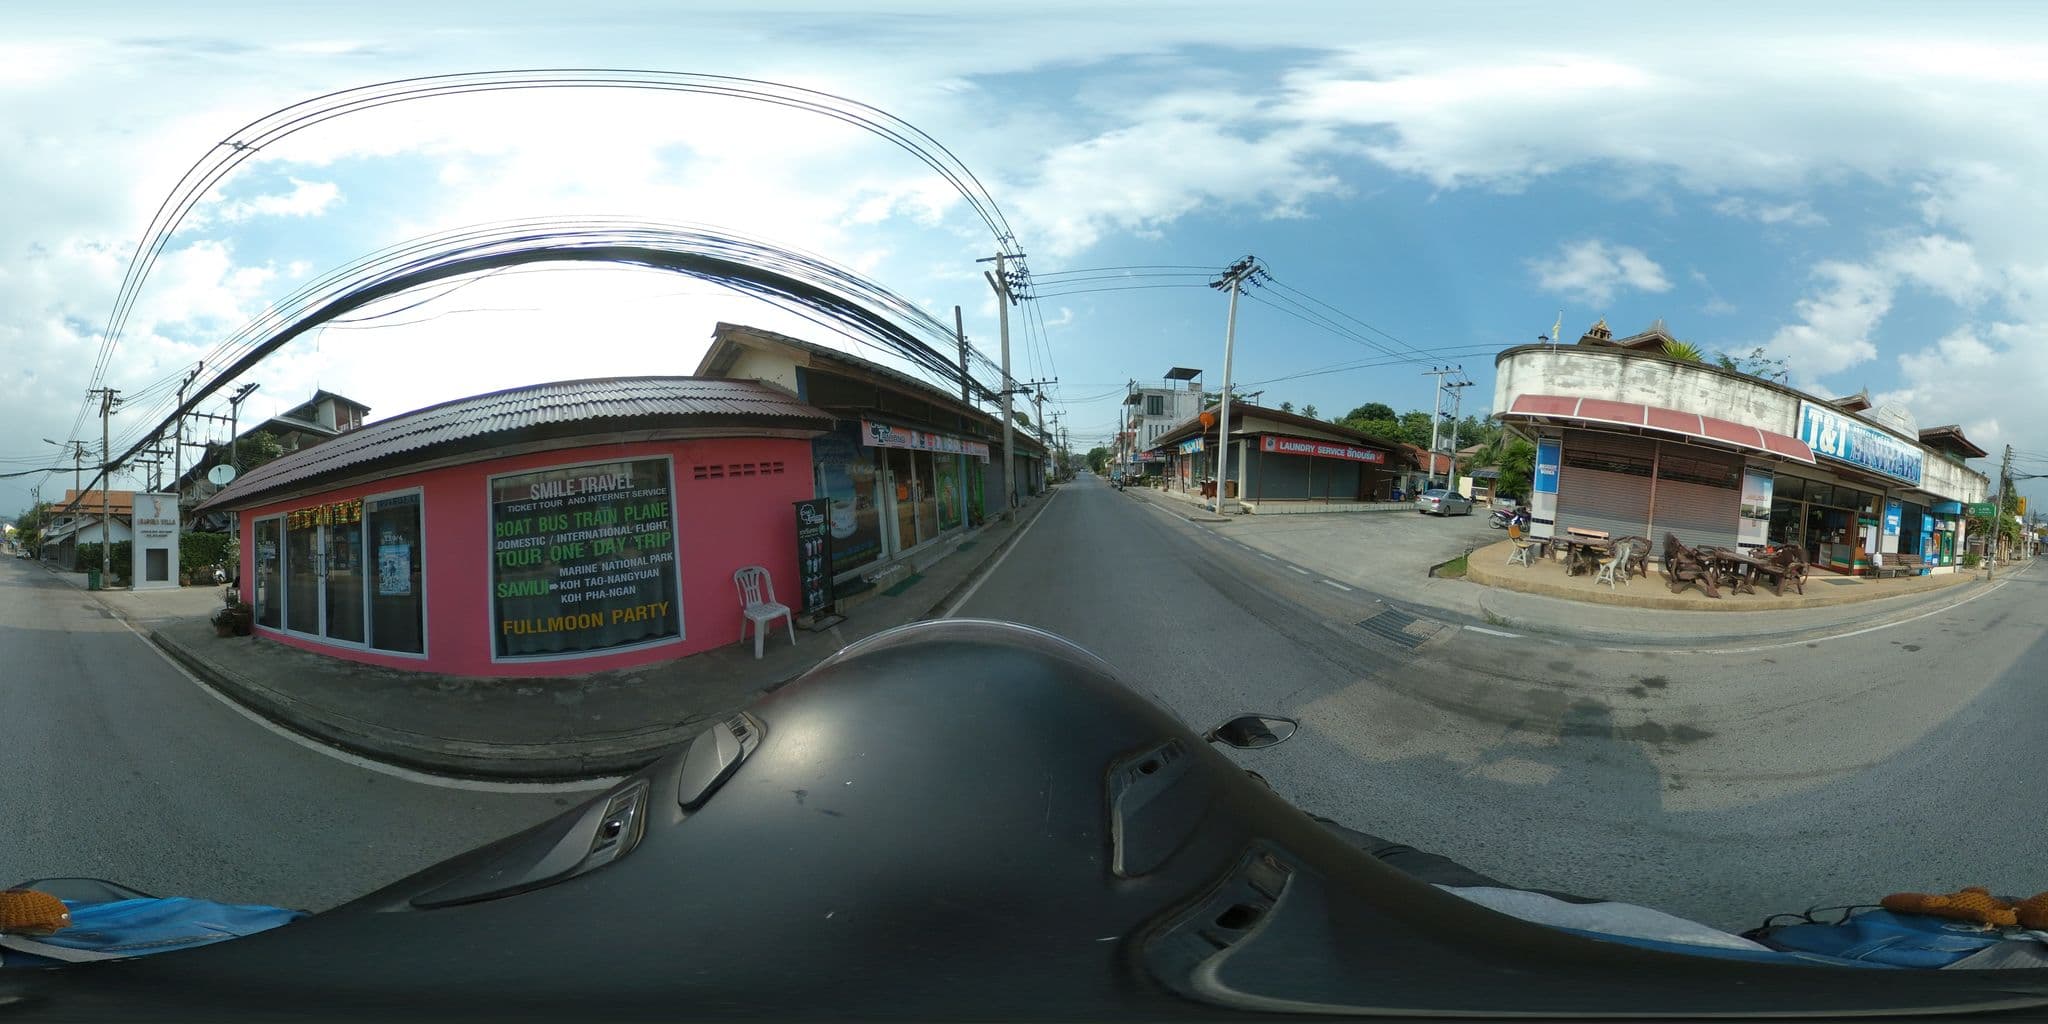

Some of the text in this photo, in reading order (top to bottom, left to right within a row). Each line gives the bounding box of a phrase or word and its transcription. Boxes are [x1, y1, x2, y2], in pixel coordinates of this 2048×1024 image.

[1808, 408, 1850, 458] T&T
[1280, 442, 1345, 457] LAUNDRY SERVICE
[508, 487, 667, 512] TICKET TOUR AND INTERNET SERVICE
[530, 473, 633, 500] SMILE TRAVEL
[497, 503, 668, 536] BOAT BUS TRAIN PLANE
[497, 536, 546, 550] DOMESTIC
[556, 527, 633, 543] INTERNATIONAL
[635, 520, 668, 533] FLIGHT
[496, 533, 672, 567] TOUR ONE DAY TRIP
[559, 552, 674, 577] MARINE NATIONAL PARK
[497, 578, 550, 598] SAMUI
[560, 568, 660, 590] KOH TAO-NANGYUAN
[561, 585, 636, 604] KOH PHA-NGAN
[504, 601, 670, 634] FULLMOON PARTY
